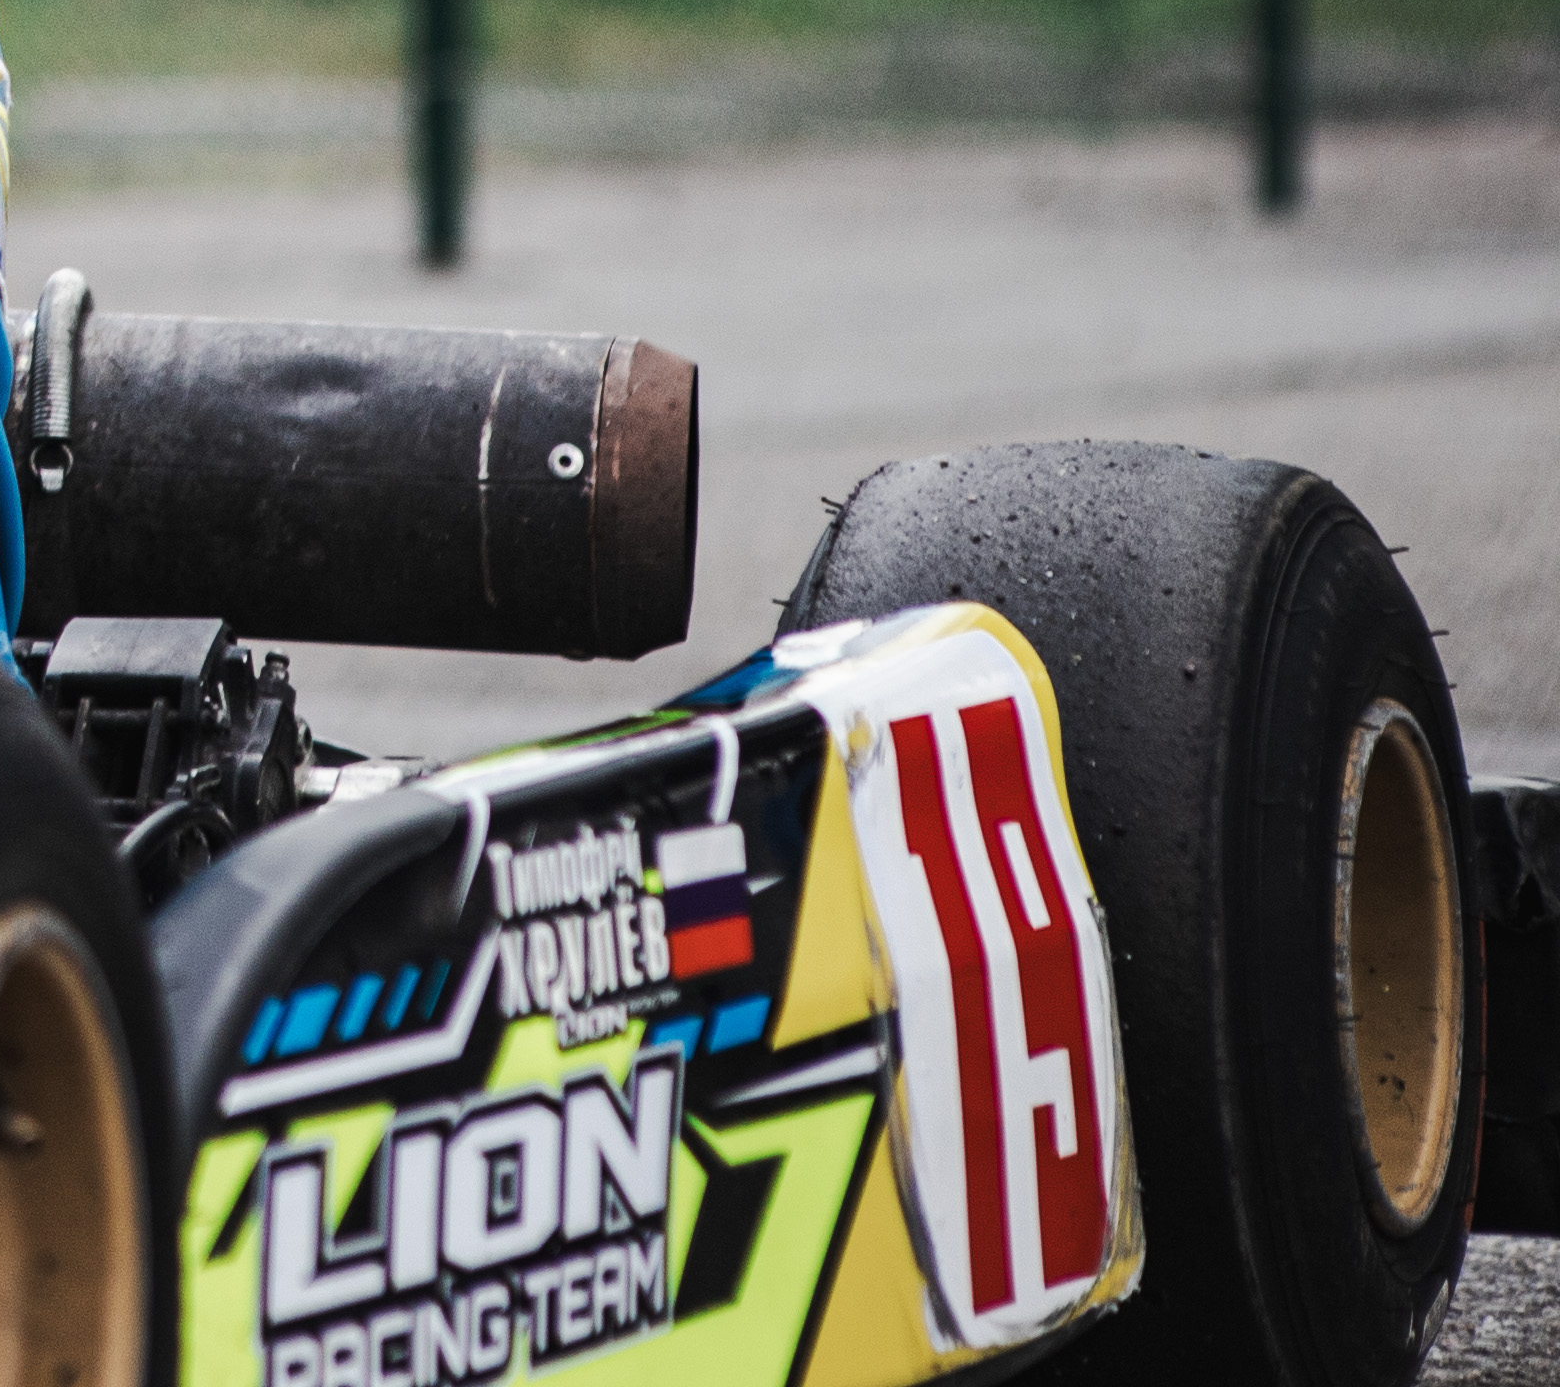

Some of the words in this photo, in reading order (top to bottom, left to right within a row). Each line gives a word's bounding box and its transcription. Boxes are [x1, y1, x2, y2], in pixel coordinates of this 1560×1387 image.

[888, 696, 1108, 1315] 19
[266, 1065, 676, 1325] LION
[269, 1280, 512, 1387] RACING
[523, 1232, 665, 1355] TEAM
